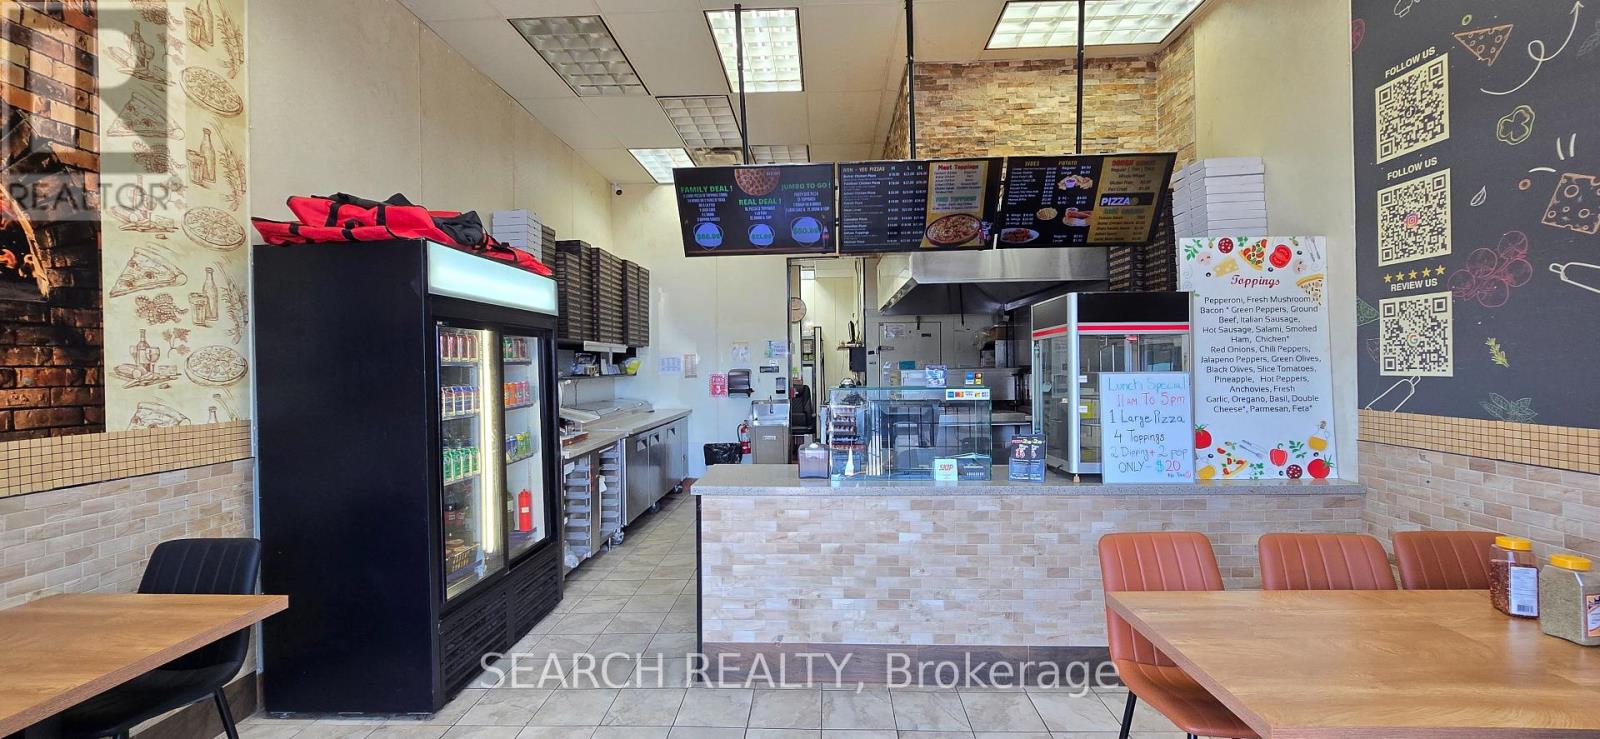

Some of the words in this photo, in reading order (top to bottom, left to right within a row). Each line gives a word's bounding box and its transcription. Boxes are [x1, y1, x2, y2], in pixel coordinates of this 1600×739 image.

[1385, 53, 1420, 78] FOLLOW
[1422, 46, 1436, 59] US
[1387, 162, 1422, 180] FOLLOW
[1425, 157, 1438, 168] US
[1101, 197, 1130, 205] PIZZA
[1231, 275, 1280, 288] Toppings
[1391, 280, 1424, 292] REVIEW
[1425, 278, 1437, 287] US
[1205, 296, 1244, 304] Pepperoni,
[1108, 378, 1143, 391] Lunch
[1276, 375, 1309, 383] Peppers,
[1109, 409, 1116, 423] 1
[1121, 410, 1152, 428] Large
[1154, 410, 1185, 424] Pizza
[1114, 430, 1122, 443] 4
[1127, 429, 1165, 444] Toppings
[1171, 449, 1187, 460] pop
[1119, 461, 1144, 473] ONLY
